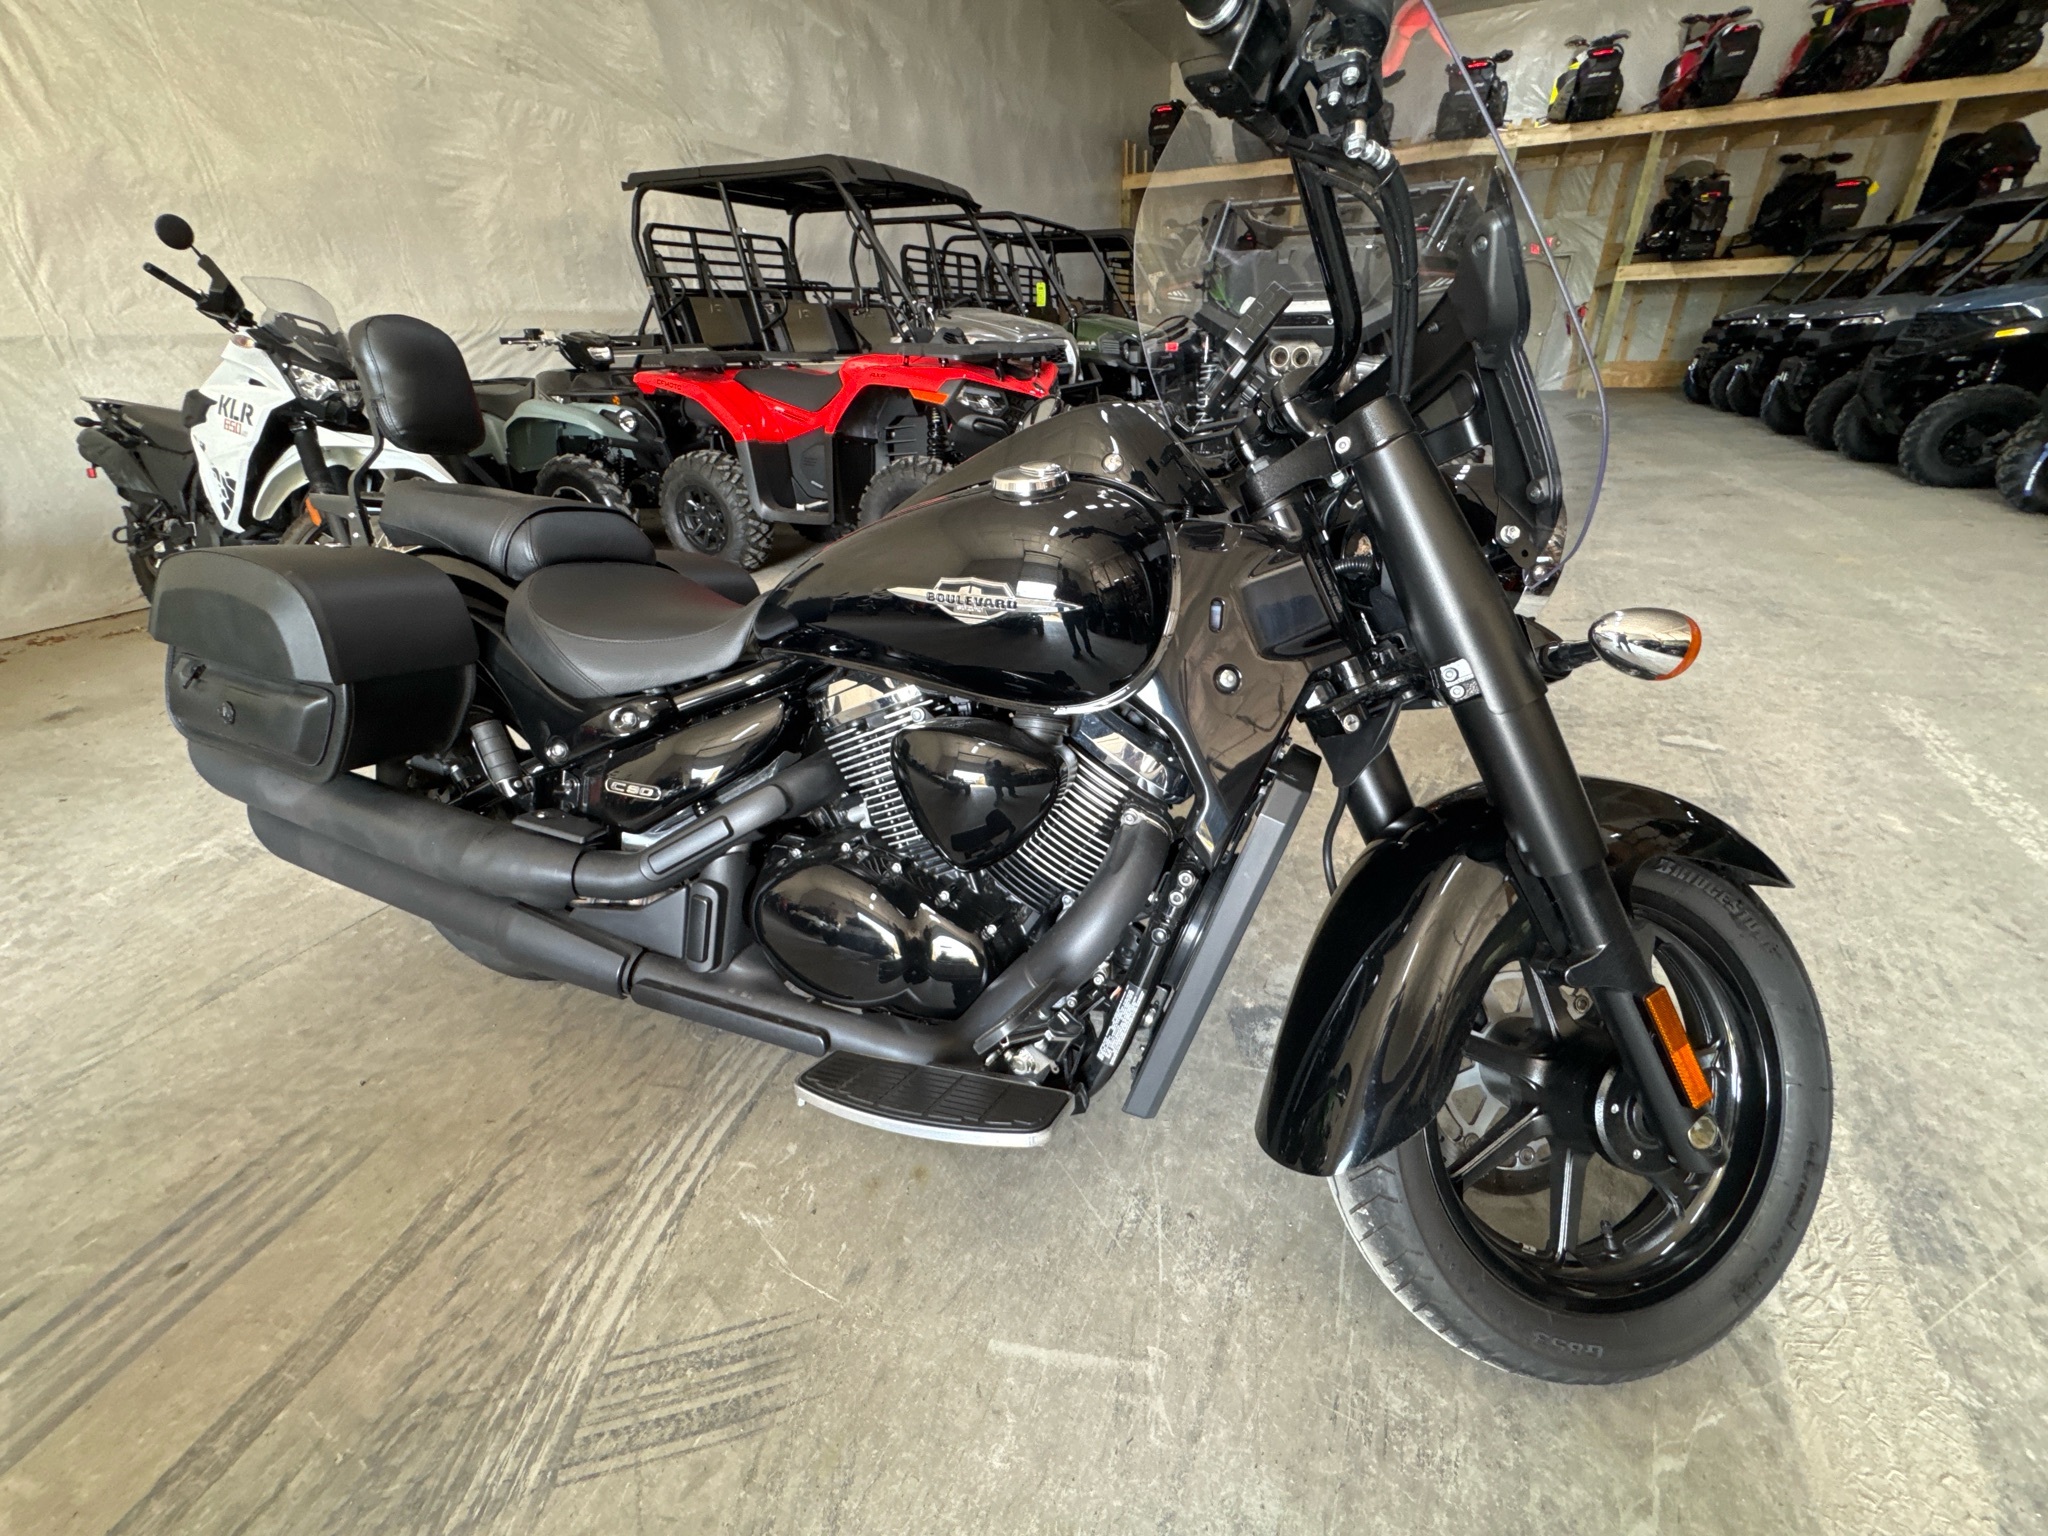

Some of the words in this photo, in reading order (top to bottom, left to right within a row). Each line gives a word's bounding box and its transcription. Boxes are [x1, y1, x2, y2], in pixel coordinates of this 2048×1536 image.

[218, 394, 254, 427] KLR
[223, 418, 242, 436] 650
[926, 591, 1018, 609] BOULEVARD
